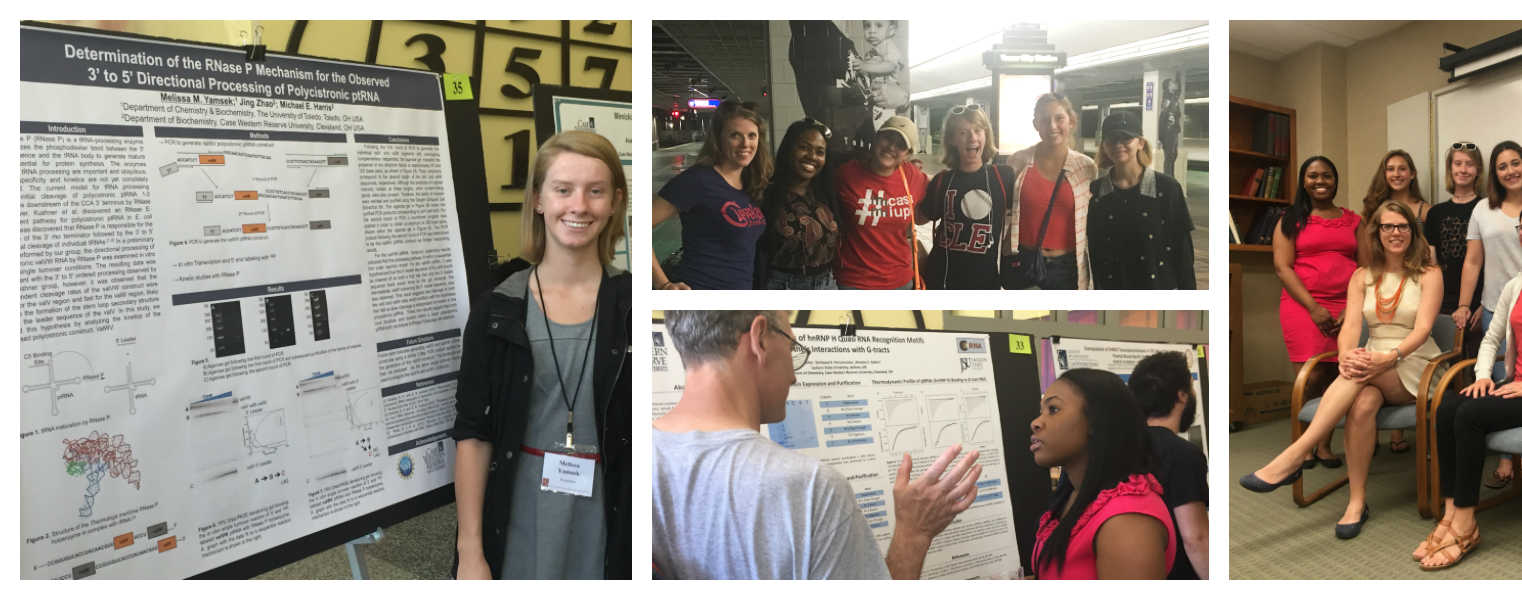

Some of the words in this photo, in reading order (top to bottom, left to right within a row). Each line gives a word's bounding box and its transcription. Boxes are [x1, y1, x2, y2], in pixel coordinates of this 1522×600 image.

[64, 43, 163, 67] Determination
[166, 55, 180, 69] of
[182, 56, 202, 70] the
[205, 58, 243, 75] RNase
[245, 62, 253, 75] P
[255, 63, 314, 81] Mechanism
[315, 70, 330, 82] for
[331, 71, 347, 84] the
[348, 73, 390, 88] Observed
[501, 46, 542, 99] 5
[103, 70, 118, 83] to
[136, 71, 206, 90] Directional
[208, 78, 272, 97] Processing
[274, 83, 287, 96] of
[287, 84, 350, 101] Polycistronic
[351, 90, 381, 103] ptRNA
[452, 81, 464, 95] 35
[160, 92, 191, 103] Melissa
[192, 94, 203, 104] M.
[239, 99, 255, 108] Jing
[280, 100, 304, 110] Michael
[306, 102, 313, 110] E.
[166, 105, 174, 113] of
[174, 105, 208, 116] Chemistry
[208, 107, 214, 115] &
[215, 107, 256, 118] Biochemistry,
[257, 110, 269, 118] The
[269, 111, 297, 121] University
[297, 112, 303, 120] of
[303, 113, 323, 122] Toledo,
[323, 114, 341, 122] Toledo,
[48, 124, 87, 134] Introduction
[167, 115, 175, 124] of
[176, 116, 219, 127] Biochemistry,
[220, 118, 236, 126] Case
[237, 119, 262, 127] Western
[263, 120, 287, 128] Reserve
[288, 121, 316, 131] University,
[316, 122, 342, 132] Cleveland,
[501, 129, 530, 190] 1
[939, 221, 992, 254] CLE
[798, 334, 806, 342] of
[807, 334, 830, 343] hnRNP
[838, 335, 856, 344] Quasi
[872, 337, 906, 346] Recognition
[1015, 340, 1025, 350] 33
[811, 345, 850, 354] Interactions
[866, 346, 890, 354] G-tracts
